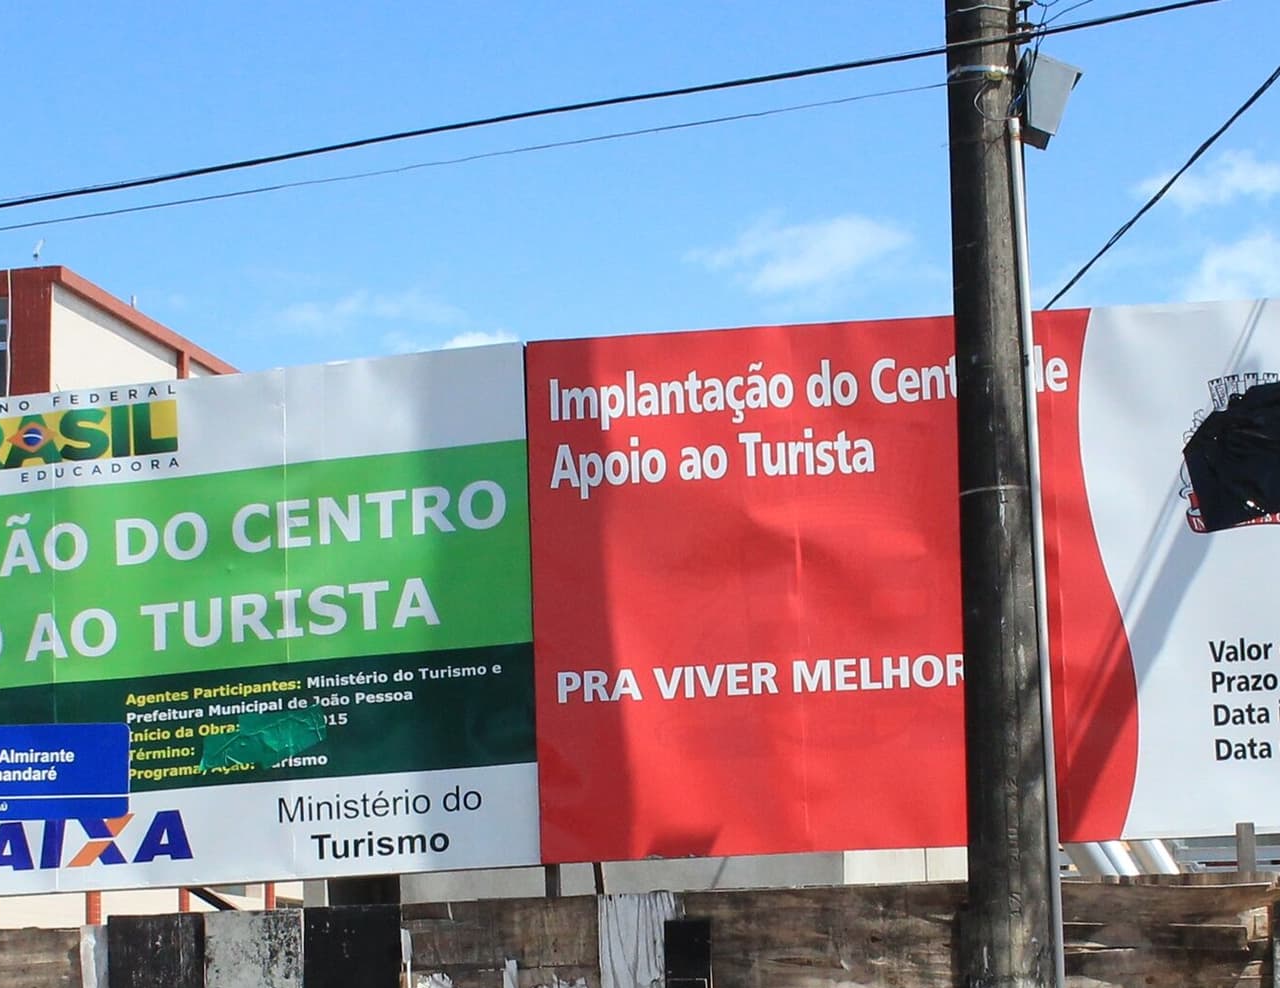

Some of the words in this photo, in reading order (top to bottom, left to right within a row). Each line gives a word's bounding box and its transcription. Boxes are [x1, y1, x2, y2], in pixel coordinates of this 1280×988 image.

[52, 384, 177, 408] FEDERAL
[549, 361, 793, 430] Implantação
[806, 359, 858, 408] do
[870, 353, 958, 405] Cent
[20, 456, 181, 483] EDUCADORA
[550, 437, 666, 499] Apoio
[680, 444, 727, 480] ao
[738, 428, 875, 478] Turista
[115, 512, 208, 566] DO
[232, 480, 507, 553] CENTRO
[26, 608, 118, 661] AO
[140, 578, 440, 651] TURISTA
[1209, 637, 1274, 663] Valor
[125, 690, 189, 707] Agentes
[194, 679, 301, 700] Participantes:
[306, 670, 388, 690] Ministério
[393, 668, 414, 682] do
[419, 664, 487, 680] Turismo
[492, 664, 502, 675] e
[557, 668, 641, 703] PRA
[653, 661, 778, 701] VIVER
[792, 654, 965, 693] MELHOR
[1211, 669, 1279, 694] Prazo
[126, 708, 203, 725] Prefeitura
[209, 699, 283, 718] Municipal
[288, 697, 308, 709] de
[356, 690, 413, 705] Pessoa
[1212, 703, 1270, 726] Data
[175, 726, 194, 739] da
[199, 722, 240, 737] Obra:
[129, 746, 195, 761] Término:
[1215, 737, 1273, 761] Data
[278, 789, 431, 824] Ministério
[442, 786, 482, 812] do
[311, 831, 450, 860] Turismo
